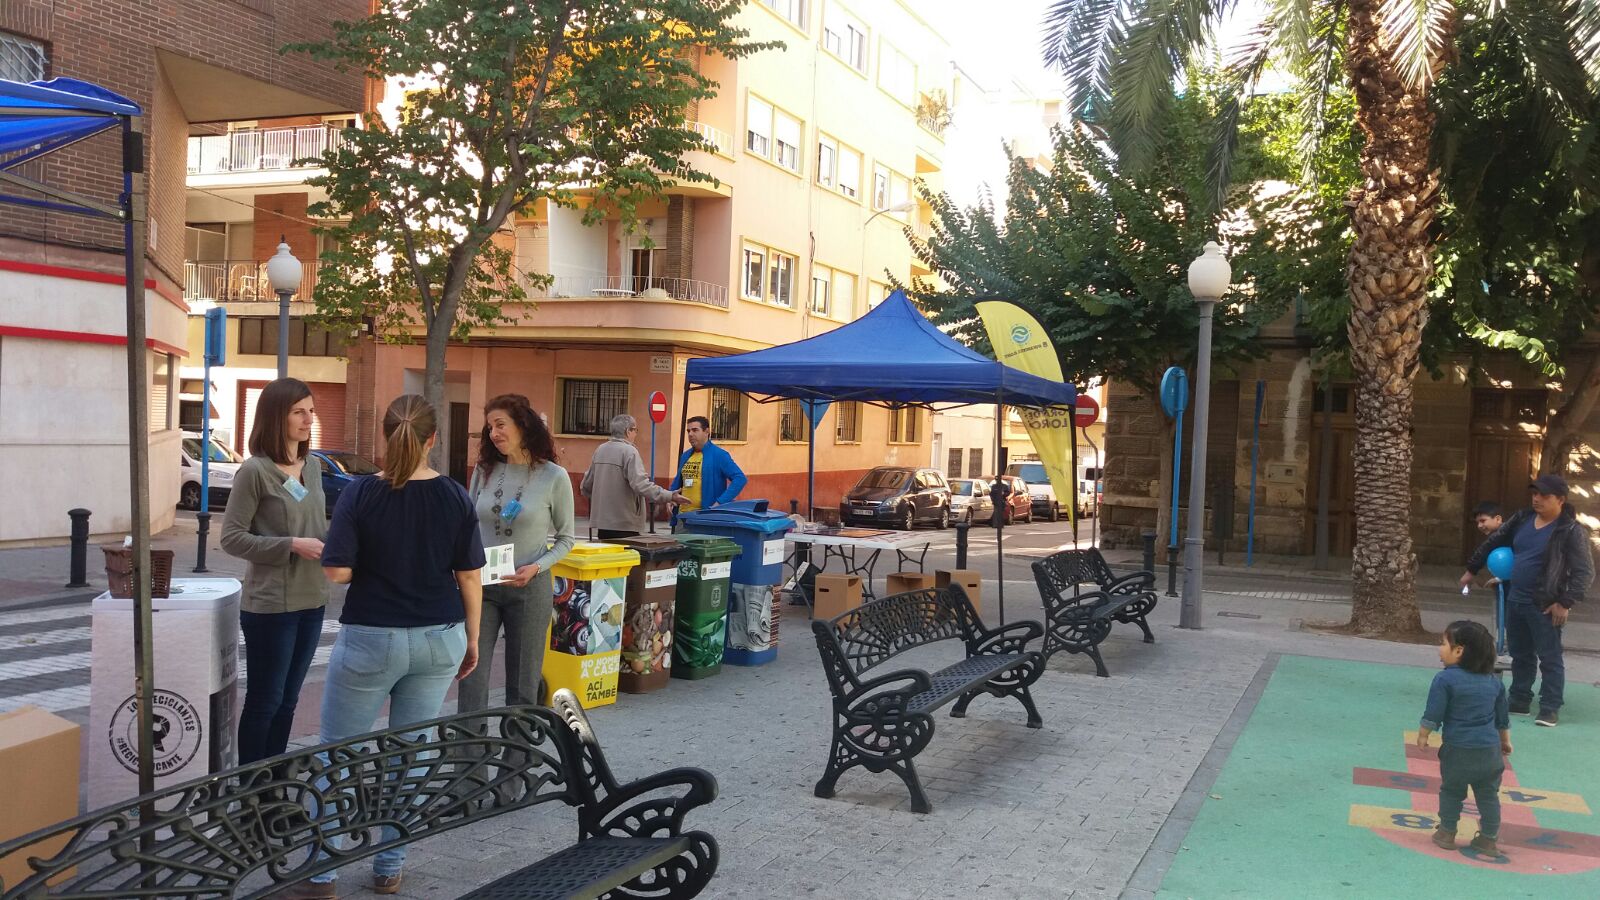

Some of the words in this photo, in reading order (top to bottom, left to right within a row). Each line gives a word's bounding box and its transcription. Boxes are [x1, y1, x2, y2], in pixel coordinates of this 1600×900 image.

[677, 559, 698, 569] MÉS
[677, 567, 698, 578] ASA
[580, 667, 589, 679] A
[593, 662, 620, 677] CASA
[586, 677, 603, 692] ACÍ
[586, 685, 616, 702] TAMBÉ
[127, 701, 139, 713] LO
[153, 695, 195, 732] ECICLANTES
[1502, 790, 1548, 803] 4
[1390, 813, 1434, 830] 8
